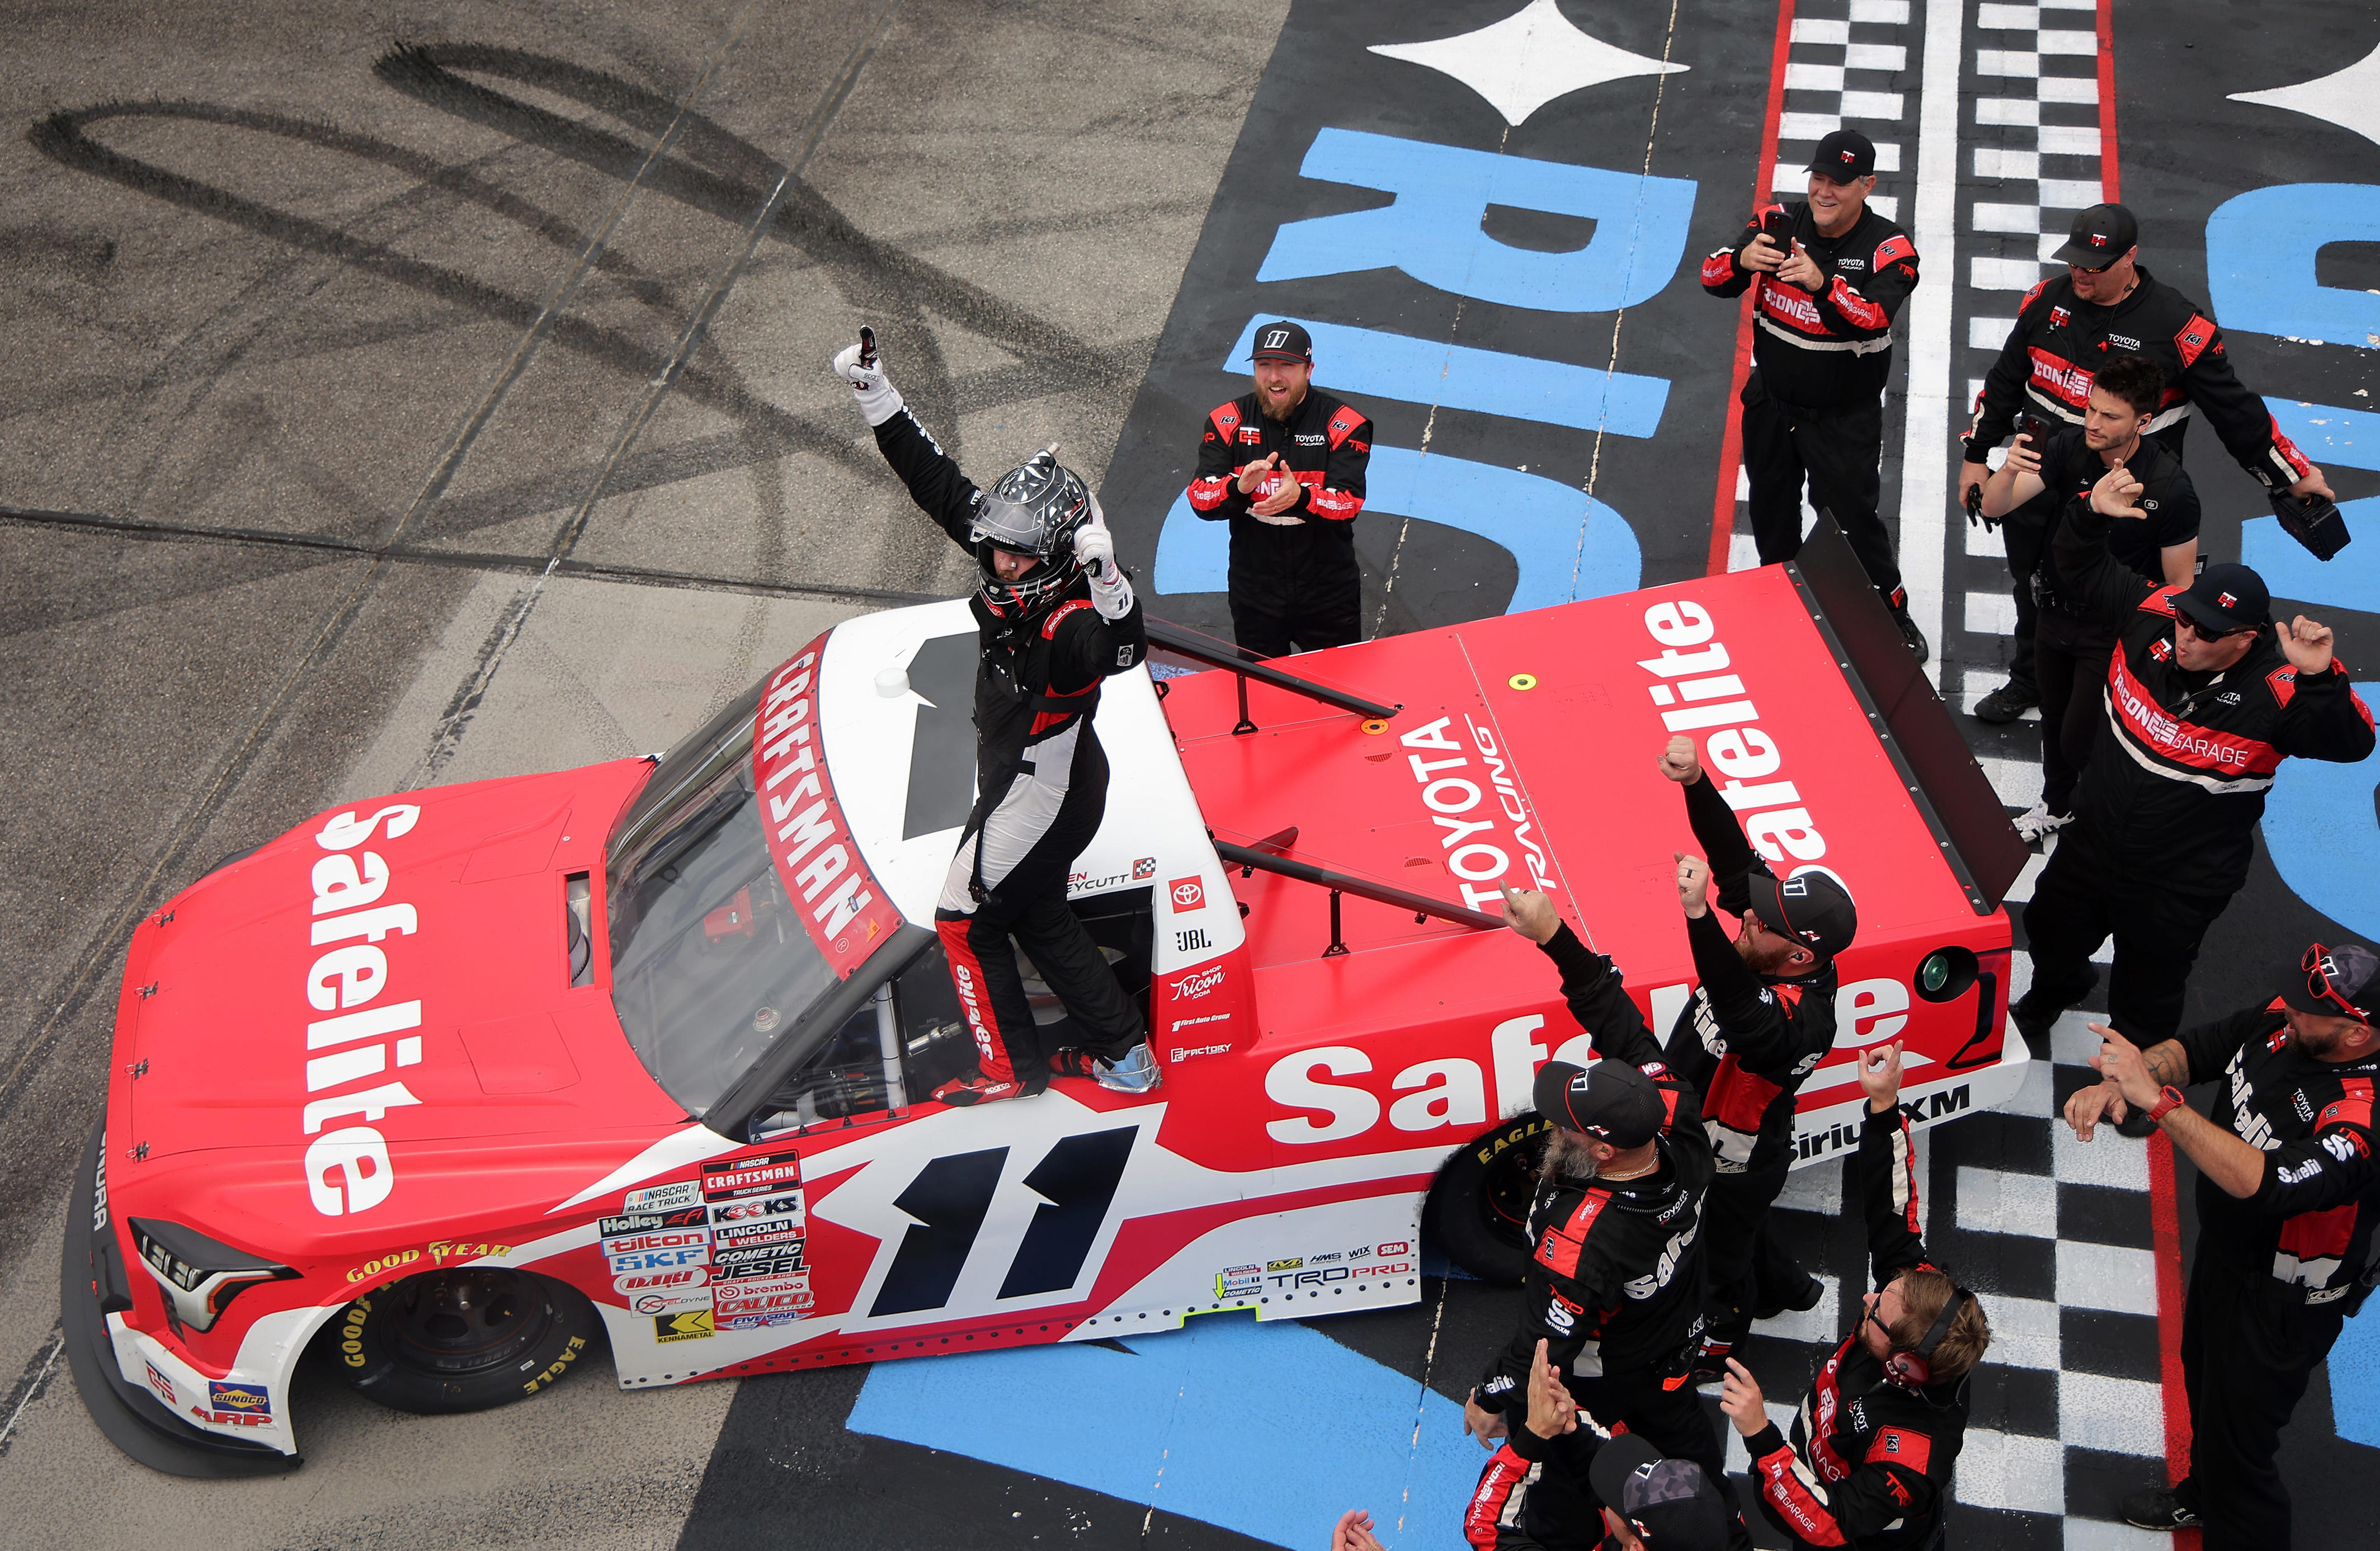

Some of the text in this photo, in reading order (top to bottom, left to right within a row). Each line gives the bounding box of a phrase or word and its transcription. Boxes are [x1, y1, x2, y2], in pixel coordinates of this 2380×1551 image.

[1879, 244, 1897, 256] K1
[1838, 258, 1864, 267] TOYOTA
[1264, 330, 1290, 348] 11
[2108, 333, 2141, 348] TOYOTA
[2183, 332, 2203, 346] K1
[1219, 416, 1237, 425] K1
[1331, 420, 1350, 431] K1
[1348, 439, 1369, 454] TRD
[1118, 592, 1128, 611] 11
[1048, 604, 1077, 633] sparco
[2172, 733, 2248, 767] GARAGE
[762, 651, 872, 942] CRAFTSMAN
[1464, 713, 1558, 893] RACING
[1400, 715, 1520, 913] TOYOTA
[1175, 928, 1212, 952] JBL
[1201, 965, 1222, 977] SHOP
[1170, 972, 1226, 1001] Tricon
[1192, 989, 1211, 1000] .COM
[304, 804, 423, 1217] Safelite
[1195, 1015, 1210, 1024] Auto
[1184, 1043, 1232, 1058] FACTORY
[1641, 1062, 1662, 1075] SEM
[984, 1082, 1011, 1095] sparco
[2294, 1088, 2314, 1121] TOYOTA
[2339, 1128, 2370, 1158] TRD
[740, 1157, 770, 1168] NASCAR
[707, 1166, 795, 1189] CRAFTSMAN
[648, 1185, 689, 1200] NASCAR
[628, 1195, 691, 1211] RACE TRUCK
[713, 1196, 798, 1223] KOOKS
[1657, 1190, 1688, 1222] TOYOTA
[602, 1215, 664, 1233] Holley
[719, 1221, 788, 1238] LINCOLN
[868, 1125, 1140, 1317] 11
[610, 1233, 703, 1252] tilton
[736, 1231, 797, 1246] WELDERS
[715, 1243, 802, 1264] COMETIC
[1310, 1252, 1342, 1262] HMS
[1349, 1245, 1370, 1257] WIX
[1381, 1243, 1405, 1255] SEM
[616, 1249, 704, 1271] SKF
[712, 1257, 809, 1280] JESEL
[1224, 1277, 1250, 1286] Mobil
[1267, 1262, 1409, 1289] TRD PRO
[744, 1282, 804, 1295] brembo
[1224, 1287, 1260, 1297] COMETIC
[719, 1292, 812, 1313] CALICO
[658, 1332, 713, 1343] KENNAMETAL
[524, 1336, 586, 1394] EAGLE
[215, 1394, 265, 1404] SUNOCO
[191, 1406, 272, 1426] ARP
[1884, 1434, 1900, 1454] K1
[1783, 1497, 1816, 1532] GARAGE
